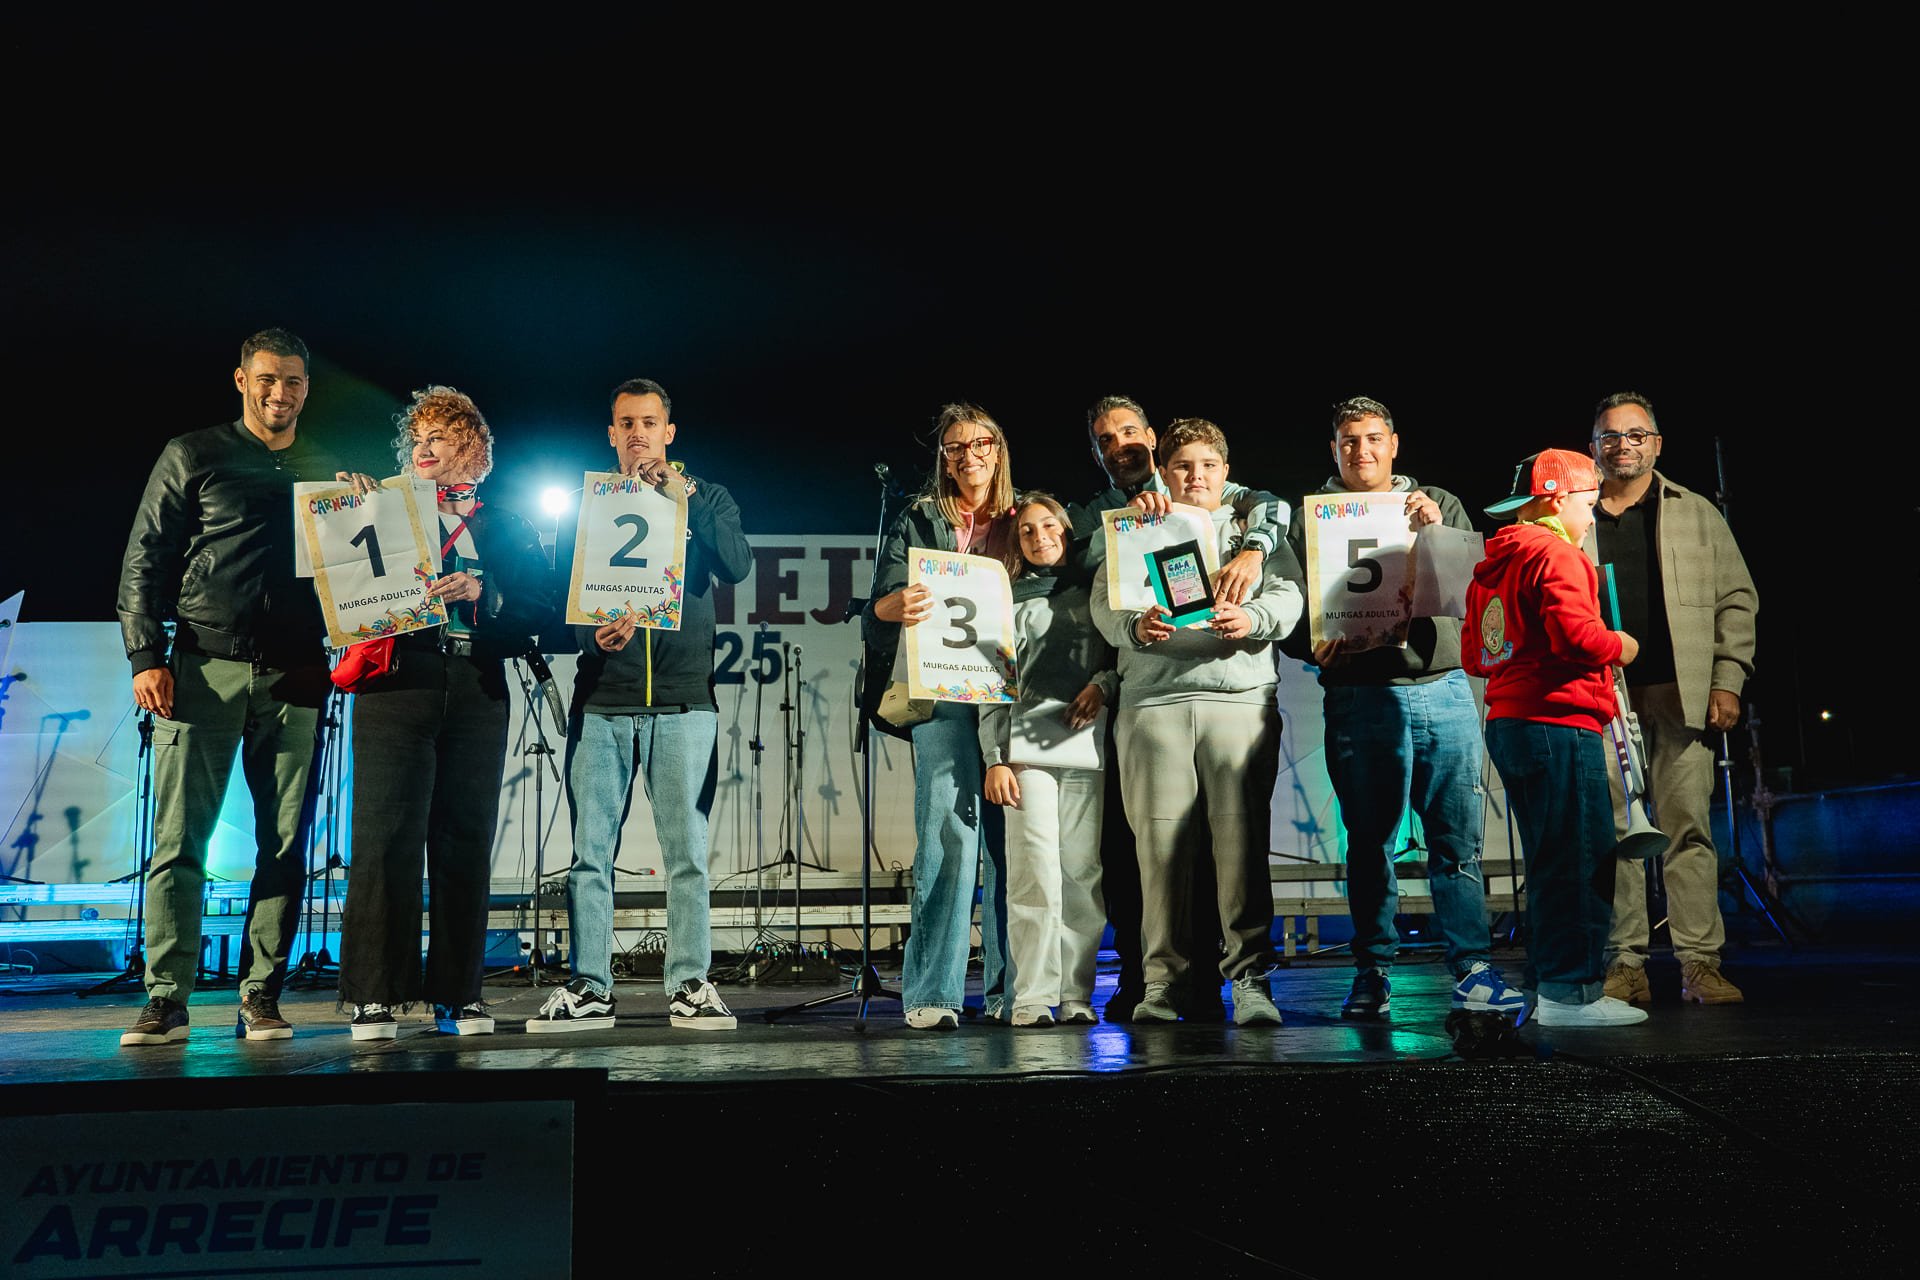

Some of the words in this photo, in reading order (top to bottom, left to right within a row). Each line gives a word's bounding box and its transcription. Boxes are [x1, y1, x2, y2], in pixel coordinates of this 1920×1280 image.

[593, 479, 643, 495] CARNAVAL
[1314, 501, 1369, 520] CARNAVAL
[350, 524, 386, 578] 1
[609, 513, 649, 568] 2
[918, 557, 969, 577] CARNAVAL
[1346, 538, 1383, 593] 5
[339, 596, 379, 611] MURGAS
[380, 587, 422, 602] ADULTAS
[585, 583, 623, 593] MURGAS
[623, 585, 665, 595] ADULTAS
[942, 596, 978, 649] 3
[1325, 611, 1363, 620] MURGAS
[1364, 609, 1400, 619] ADULTAS
[923, 661, 960, 671] MURGAS
[961, 664, 1000, 673] ADULTAS
[22, 1152, 409, 1196] AYUNTAMIENTO
[427, 1152, 487, 1181] DE
[13, 1194, 438, 1264] ARRECIFE
